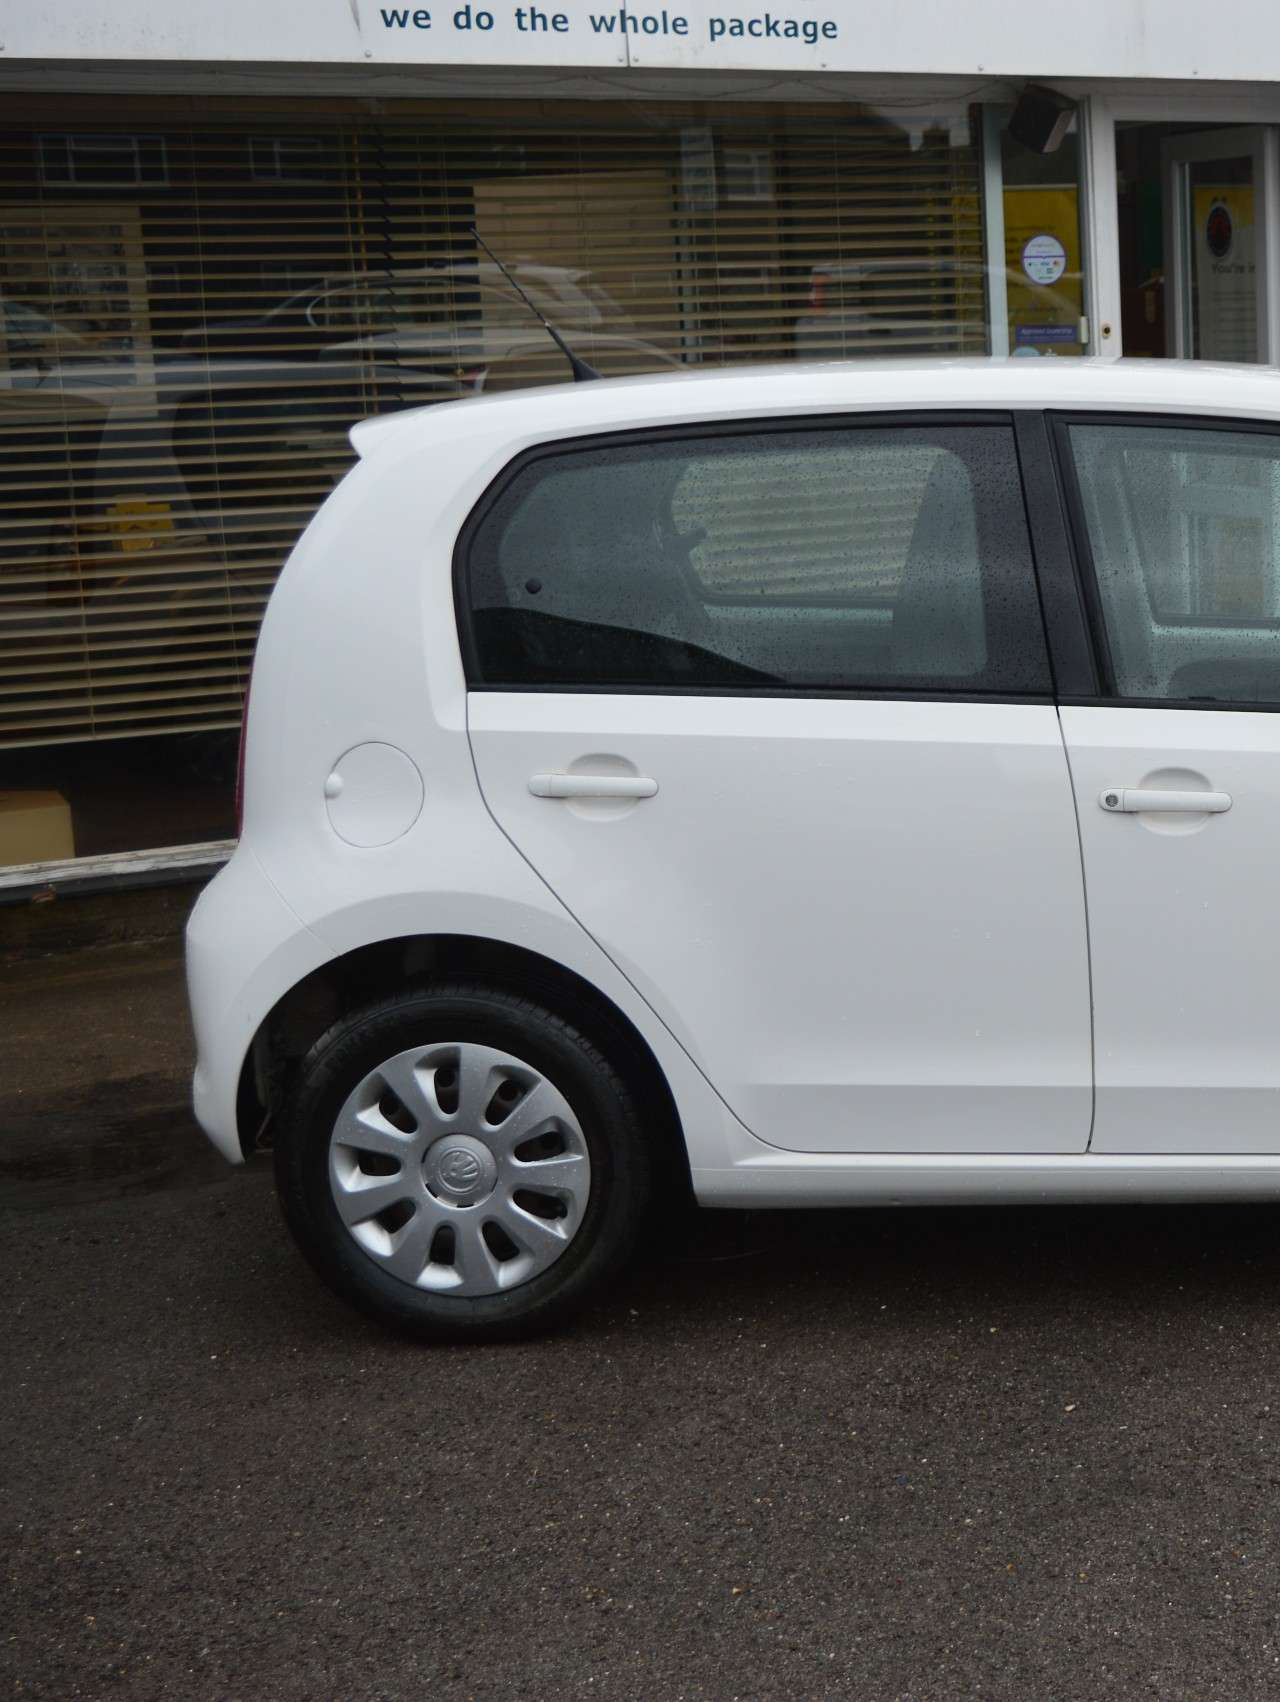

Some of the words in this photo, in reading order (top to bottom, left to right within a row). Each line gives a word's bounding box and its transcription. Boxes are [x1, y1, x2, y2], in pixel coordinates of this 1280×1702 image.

[380, 6, 432, 31] we
[453, 4, 495, 32] do
[514, 5, 570, 33] the
[589, 9, 690, 36] whole
[709, 13, 839, 44] package
